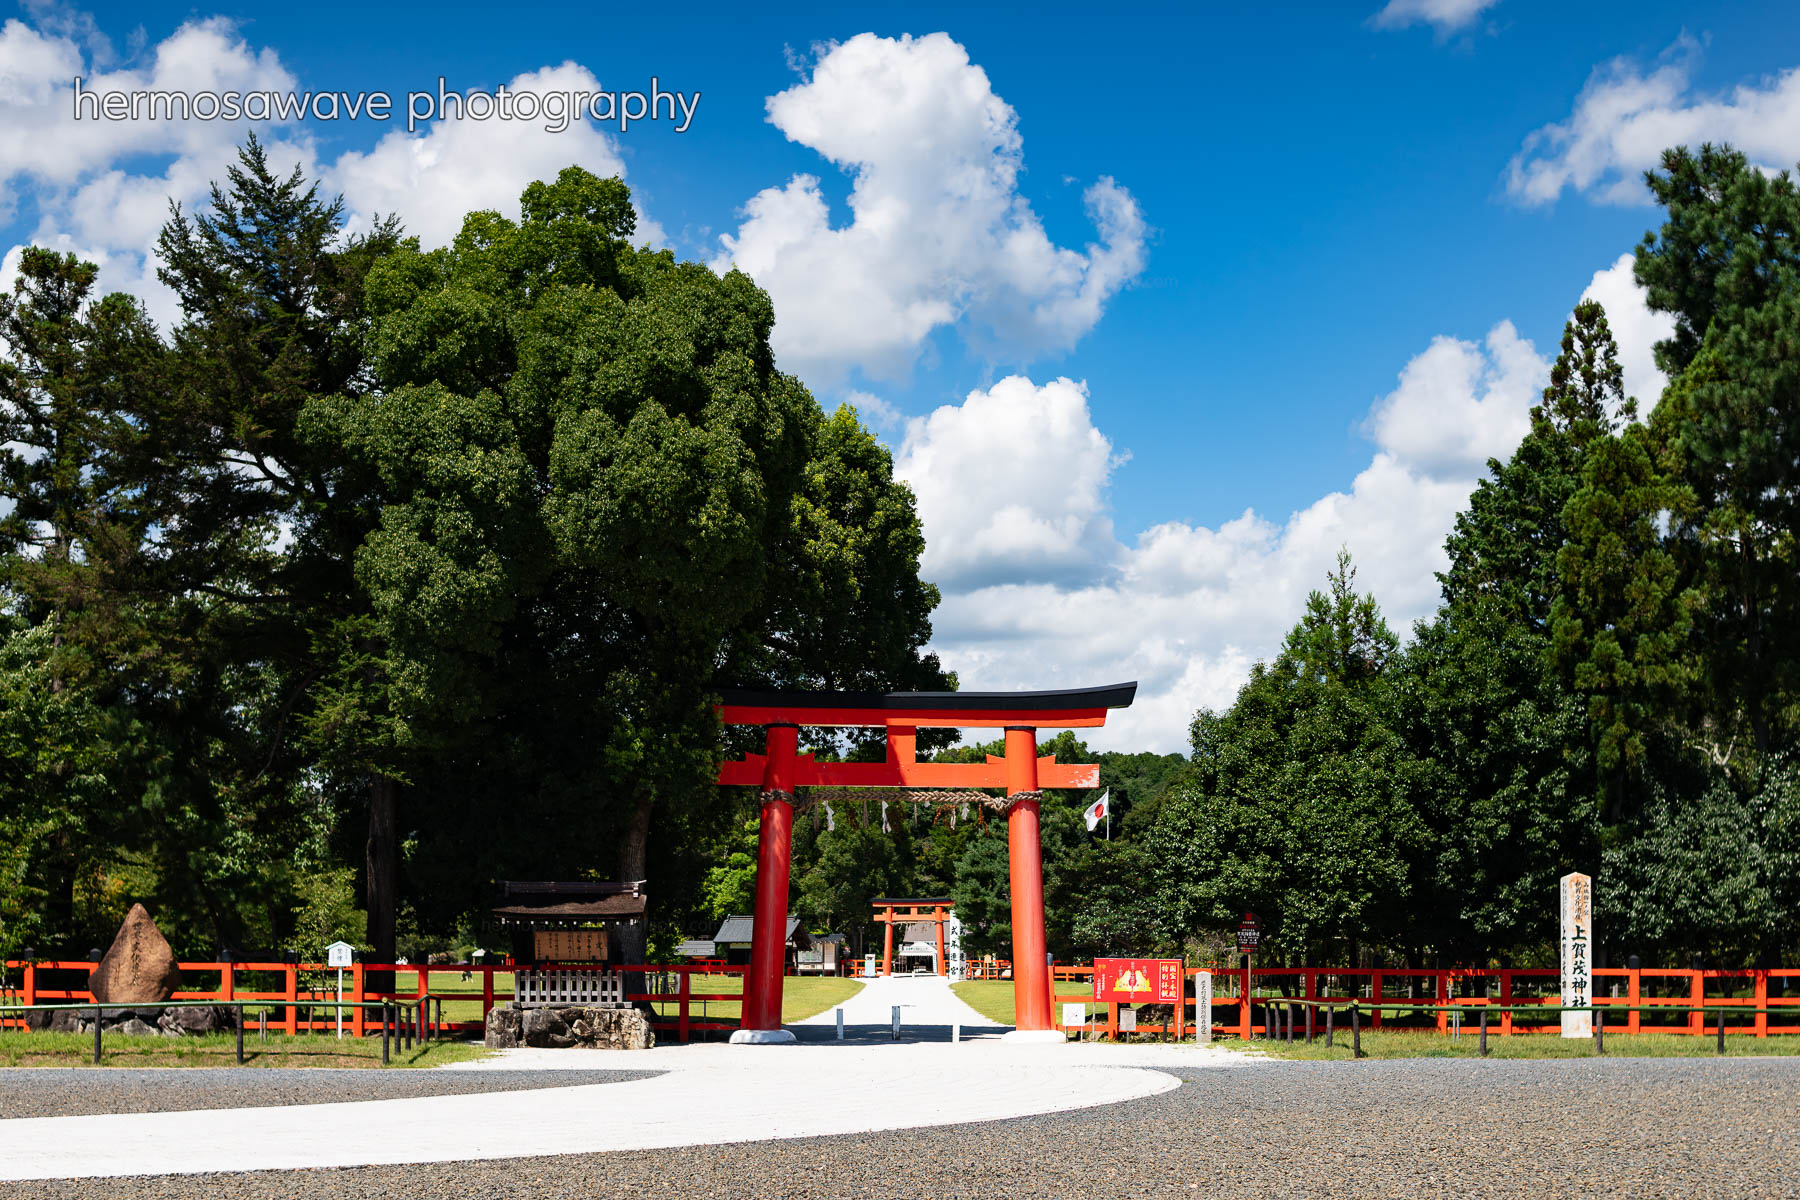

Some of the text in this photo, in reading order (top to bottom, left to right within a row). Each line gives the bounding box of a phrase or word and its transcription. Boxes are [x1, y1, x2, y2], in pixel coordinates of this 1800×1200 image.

[1571, 925, 1588, 1007] 上賀茂神社
